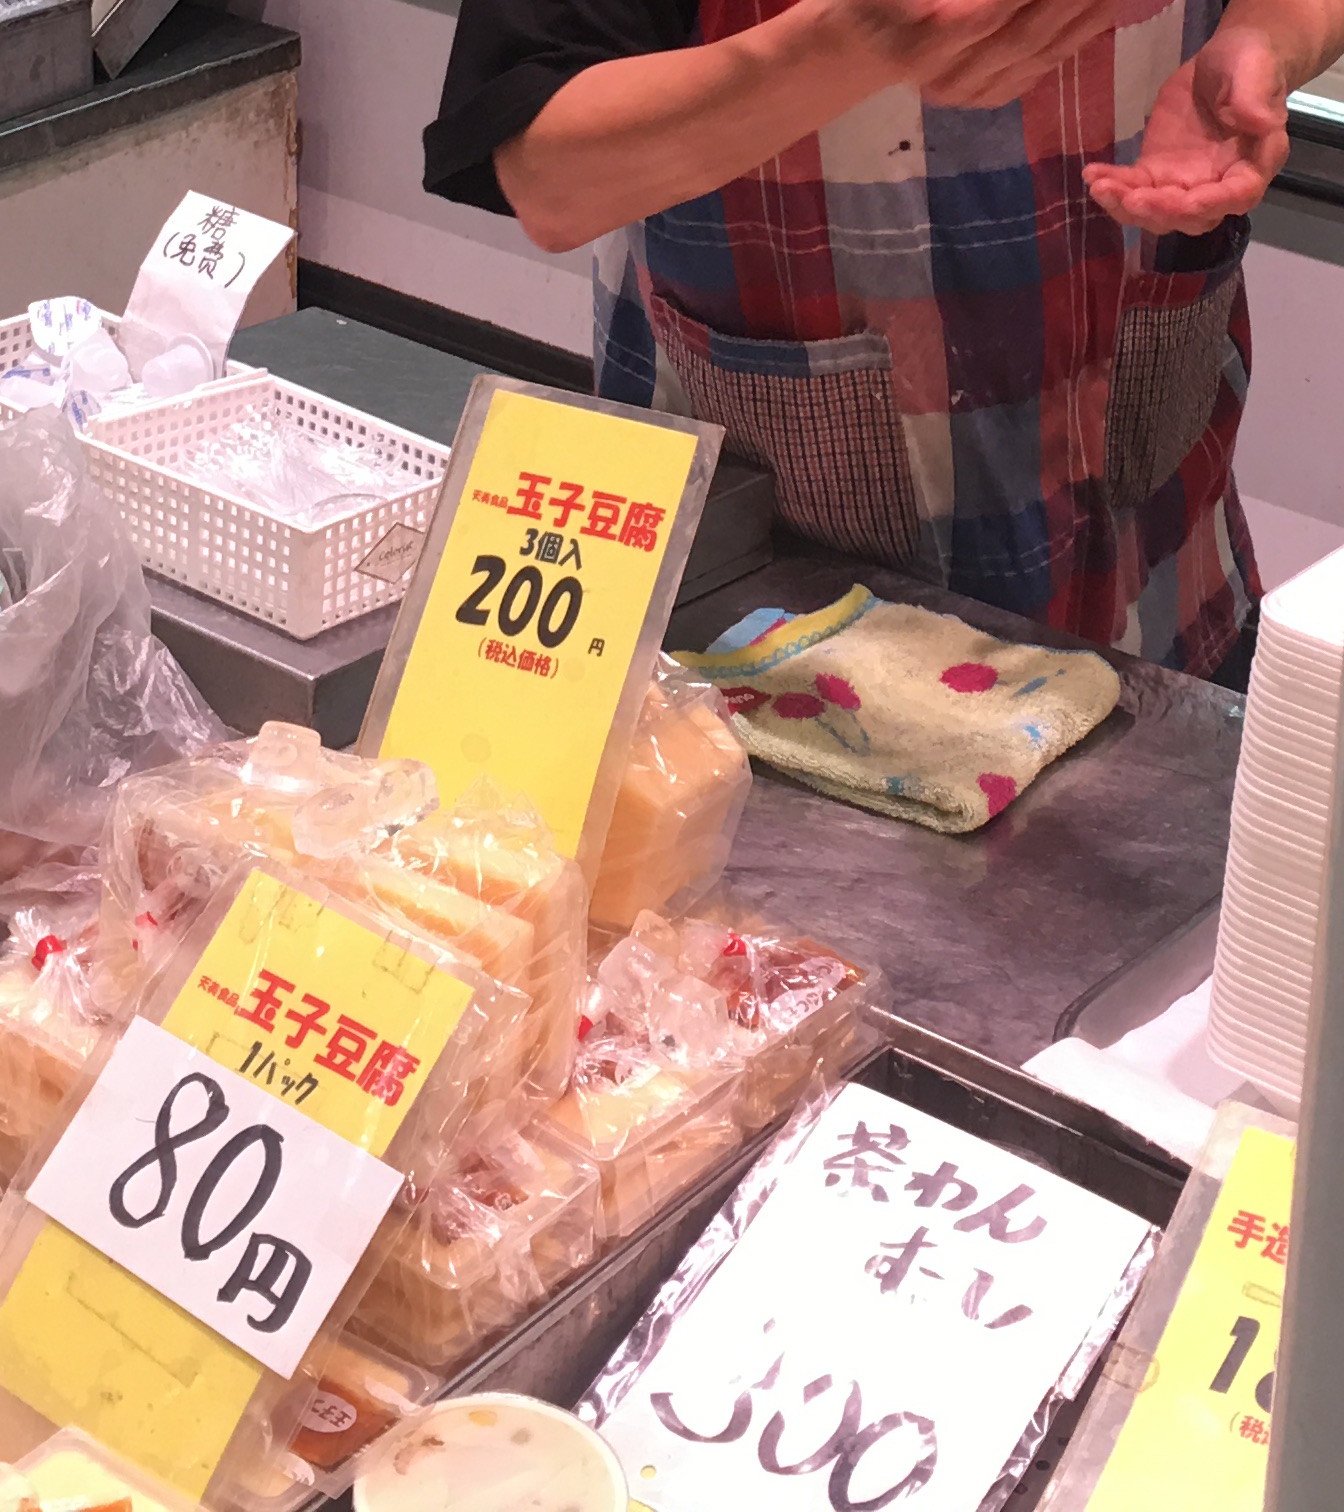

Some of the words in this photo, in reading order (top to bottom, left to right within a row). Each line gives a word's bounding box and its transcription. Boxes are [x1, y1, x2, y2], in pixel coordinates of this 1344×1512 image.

[197, 205, 240, 240] 糖
[506, 471, 667, 552] 玉子豆腐
[519, 528, 583, 570] 3個入
[455, 554, 584, 649] 200
[587, 637, 606, 658] 円
[477, 637, 560, 680] (税込価格)
[235, 1040, 320, 1106] 1パック
[237, 968, 422, 1108] 玉子豆腐
[108, 1071, 313, 1335] 80円
[823, 1120, 1047, 1245] 茶わん
